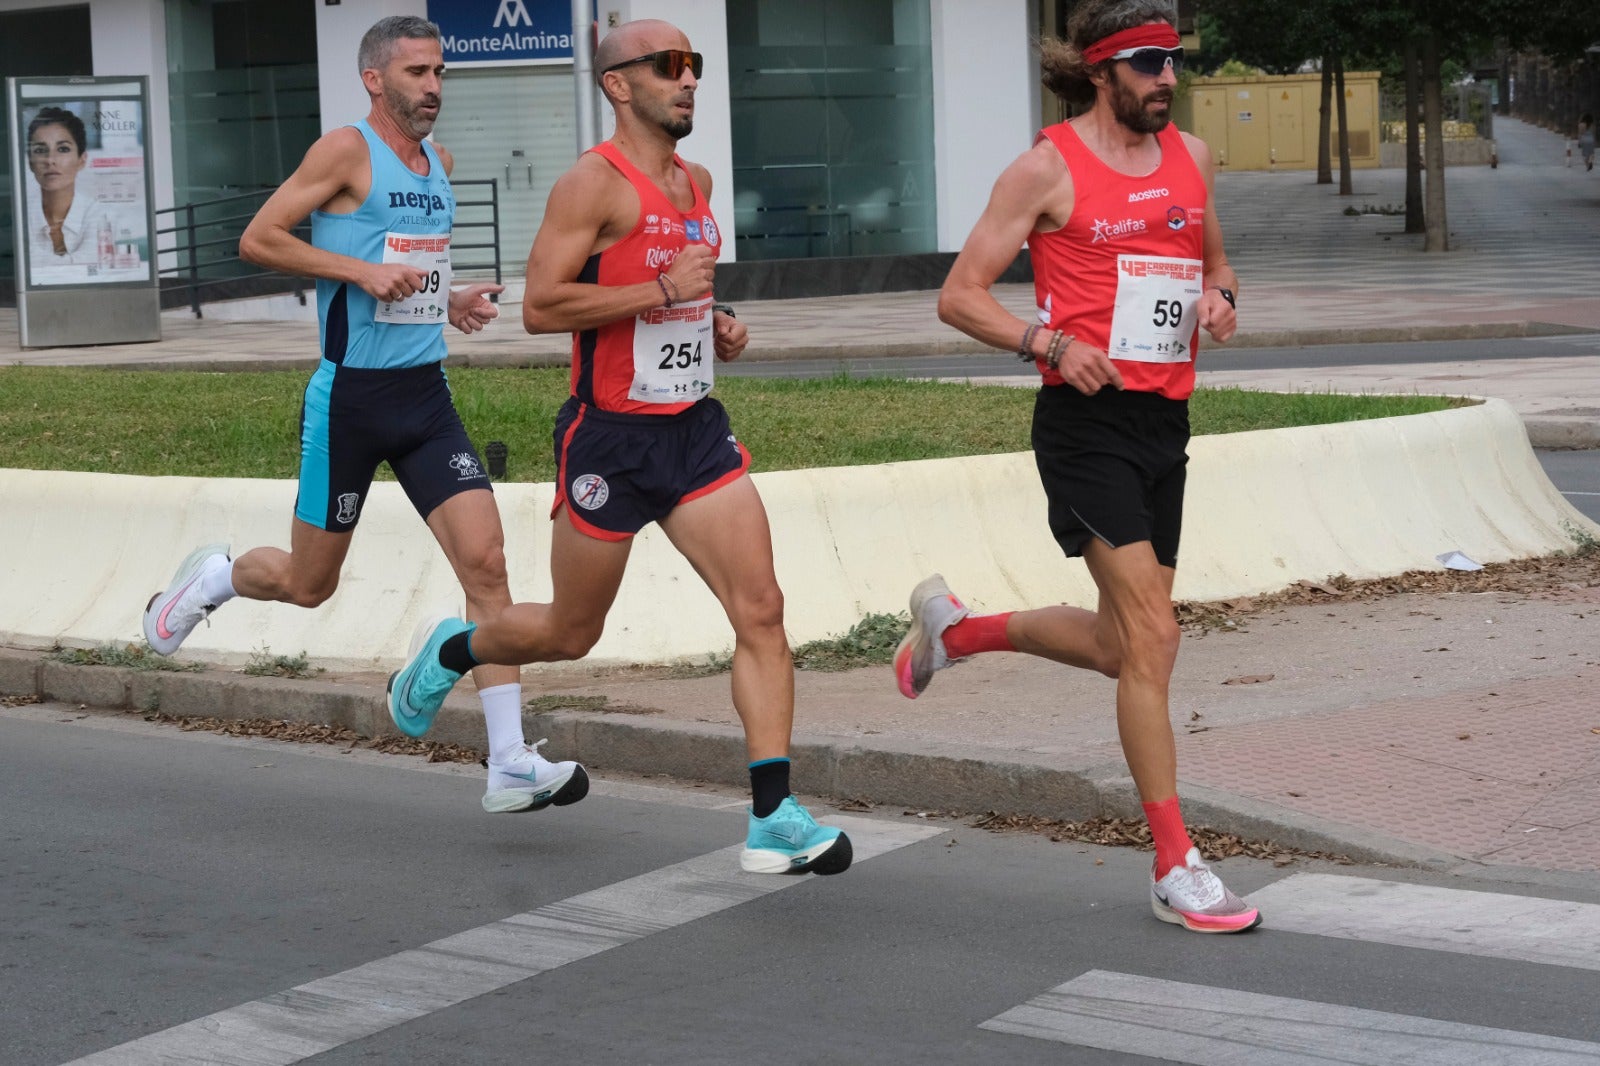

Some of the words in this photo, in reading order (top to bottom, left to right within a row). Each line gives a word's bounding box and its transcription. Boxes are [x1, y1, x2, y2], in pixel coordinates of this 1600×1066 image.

[388, 188, 445, 216] nerja
[1105, 218, 1146, 236] califas
[388, 237, 411, 253] 42
[1121, 260, 1147, 277] 42
[1152, 299, 1183, 328] 59
[658, 340, 702, 369] 254
